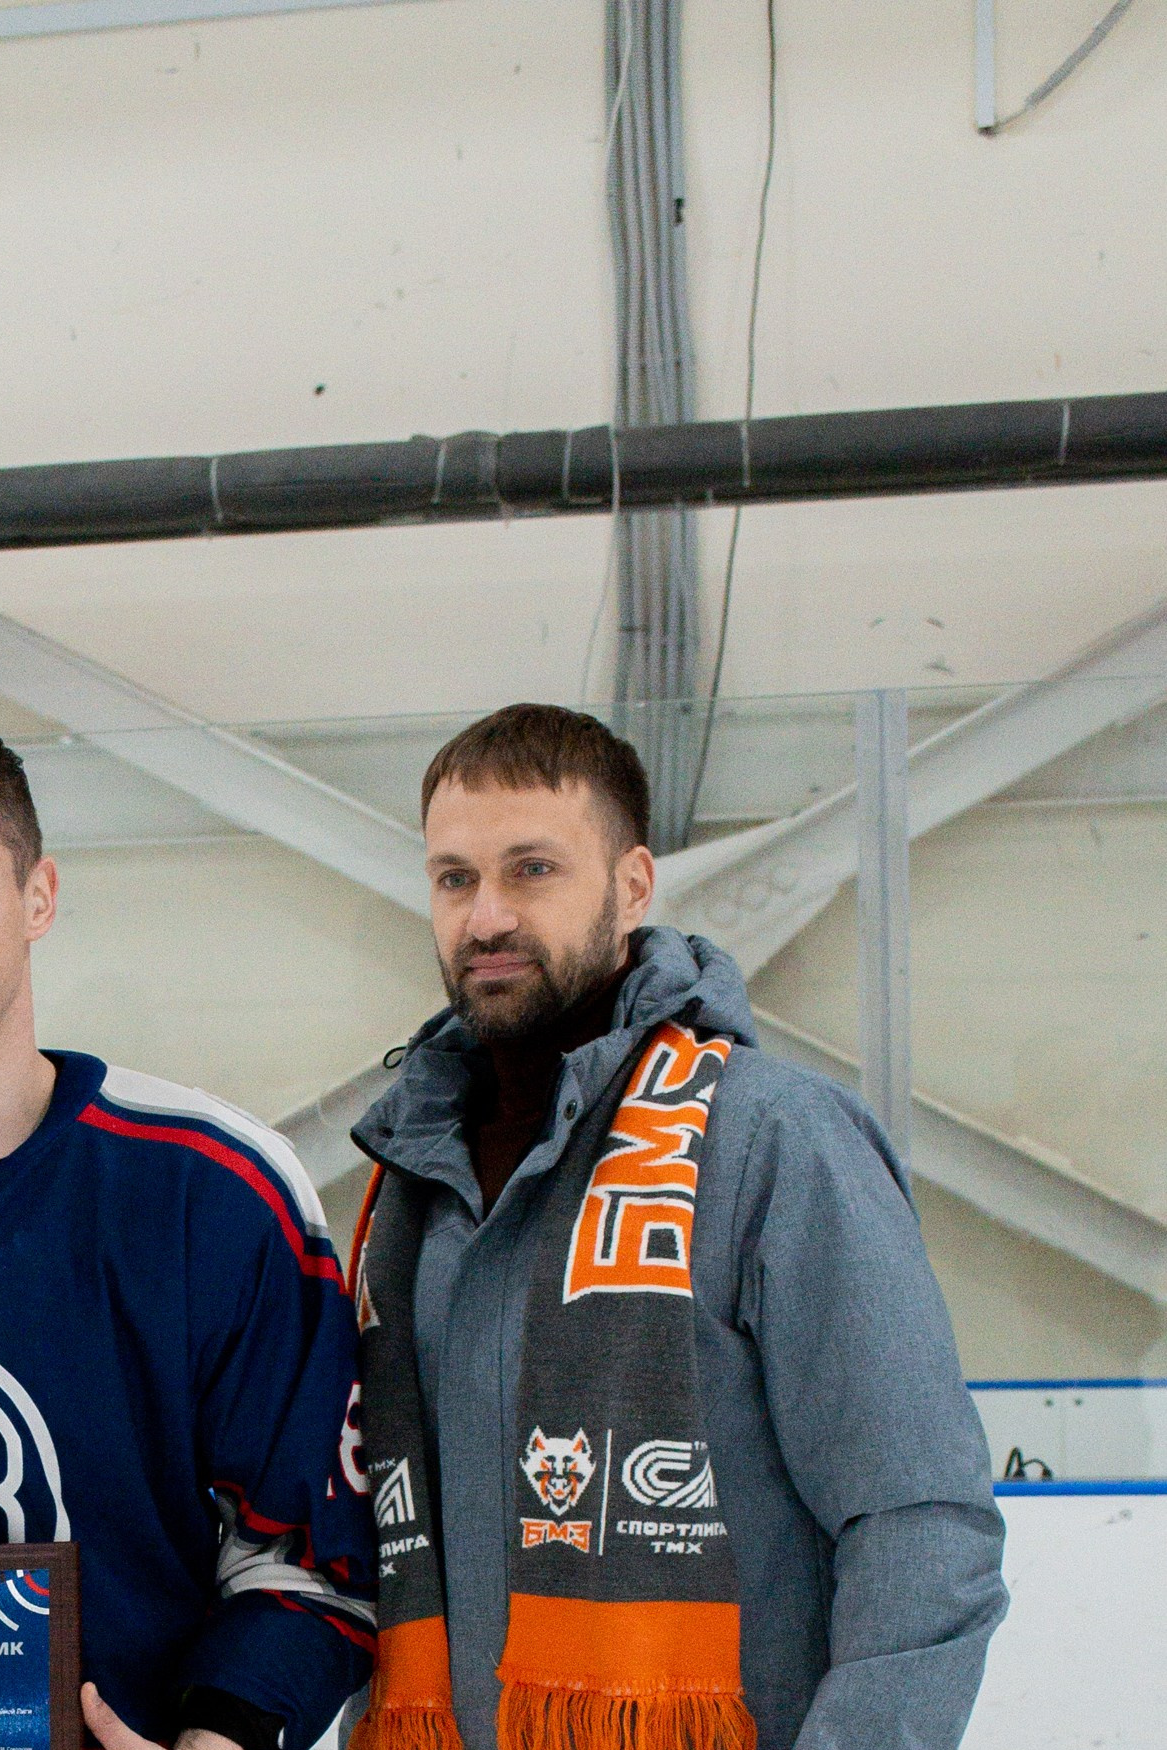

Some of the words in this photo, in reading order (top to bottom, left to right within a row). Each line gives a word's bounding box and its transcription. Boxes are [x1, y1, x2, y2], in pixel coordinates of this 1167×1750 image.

[519, 1517, 592, 1553] БМЗ
[616, 1519, 729, 1537] СПОРТЛИГА
[650, 1541, 703, 1555] ТМХ
